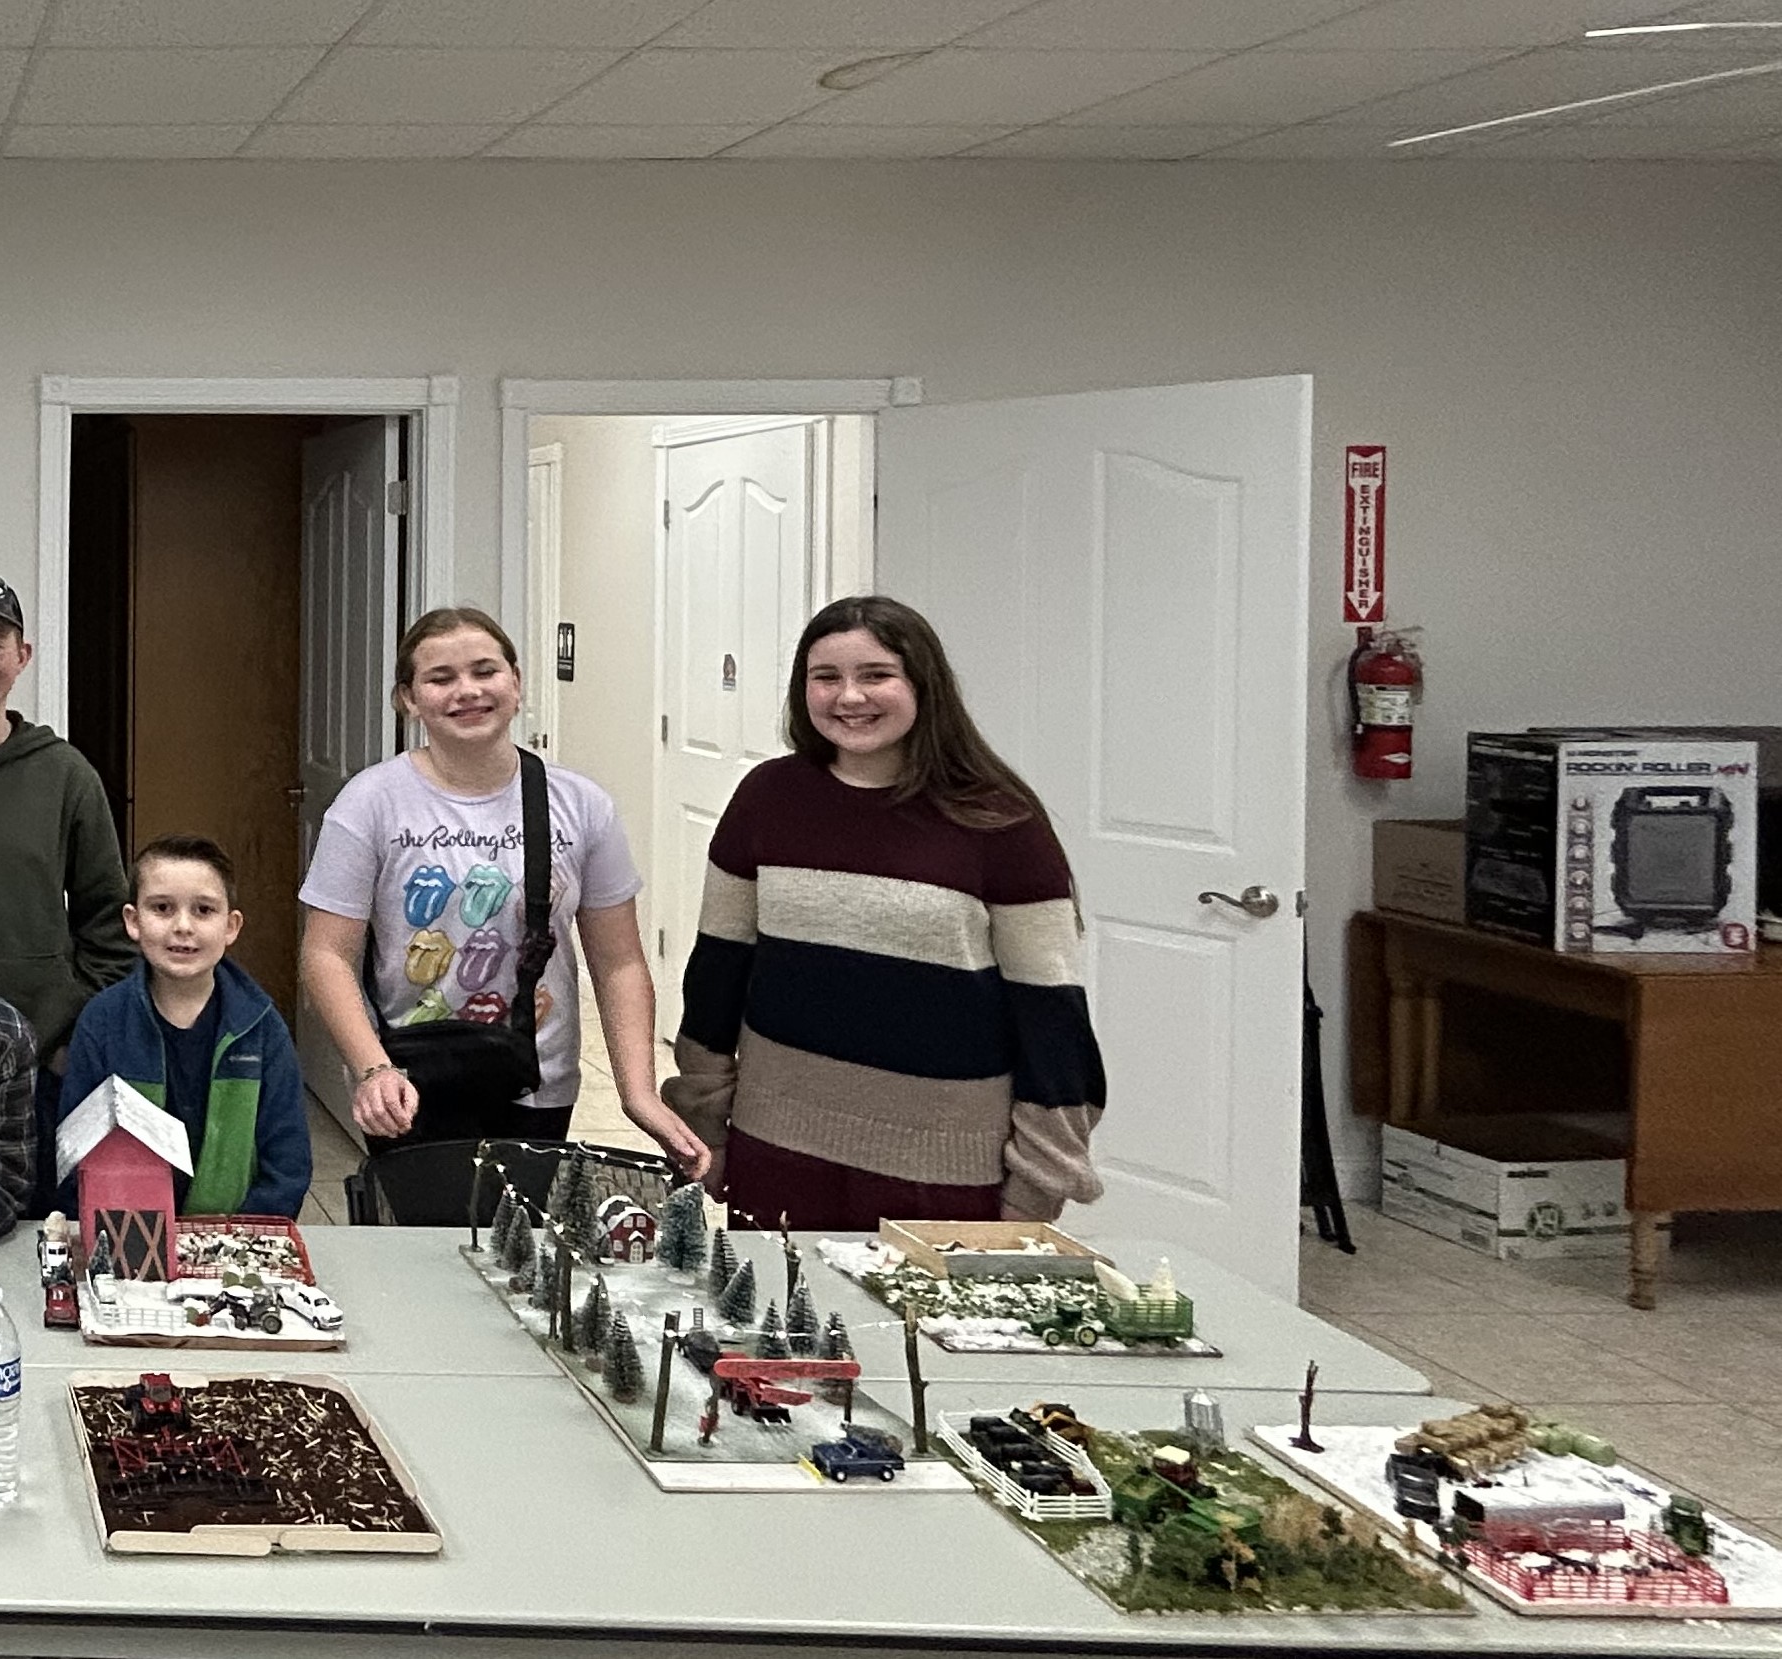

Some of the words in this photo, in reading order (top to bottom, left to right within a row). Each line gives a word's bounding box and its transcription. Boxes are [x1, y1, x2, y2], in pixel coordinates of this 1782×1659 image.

[1351, 462, 1379, 478] FIRE
[1358, 484, 1371, 609] EXTINGUISHER
[1642, 762, 1711, 773] ROLLER
[391, 828, 424, 849] the
[423, 825, 501, 861] Rolling
[501, 824, 573, 853] Sts
